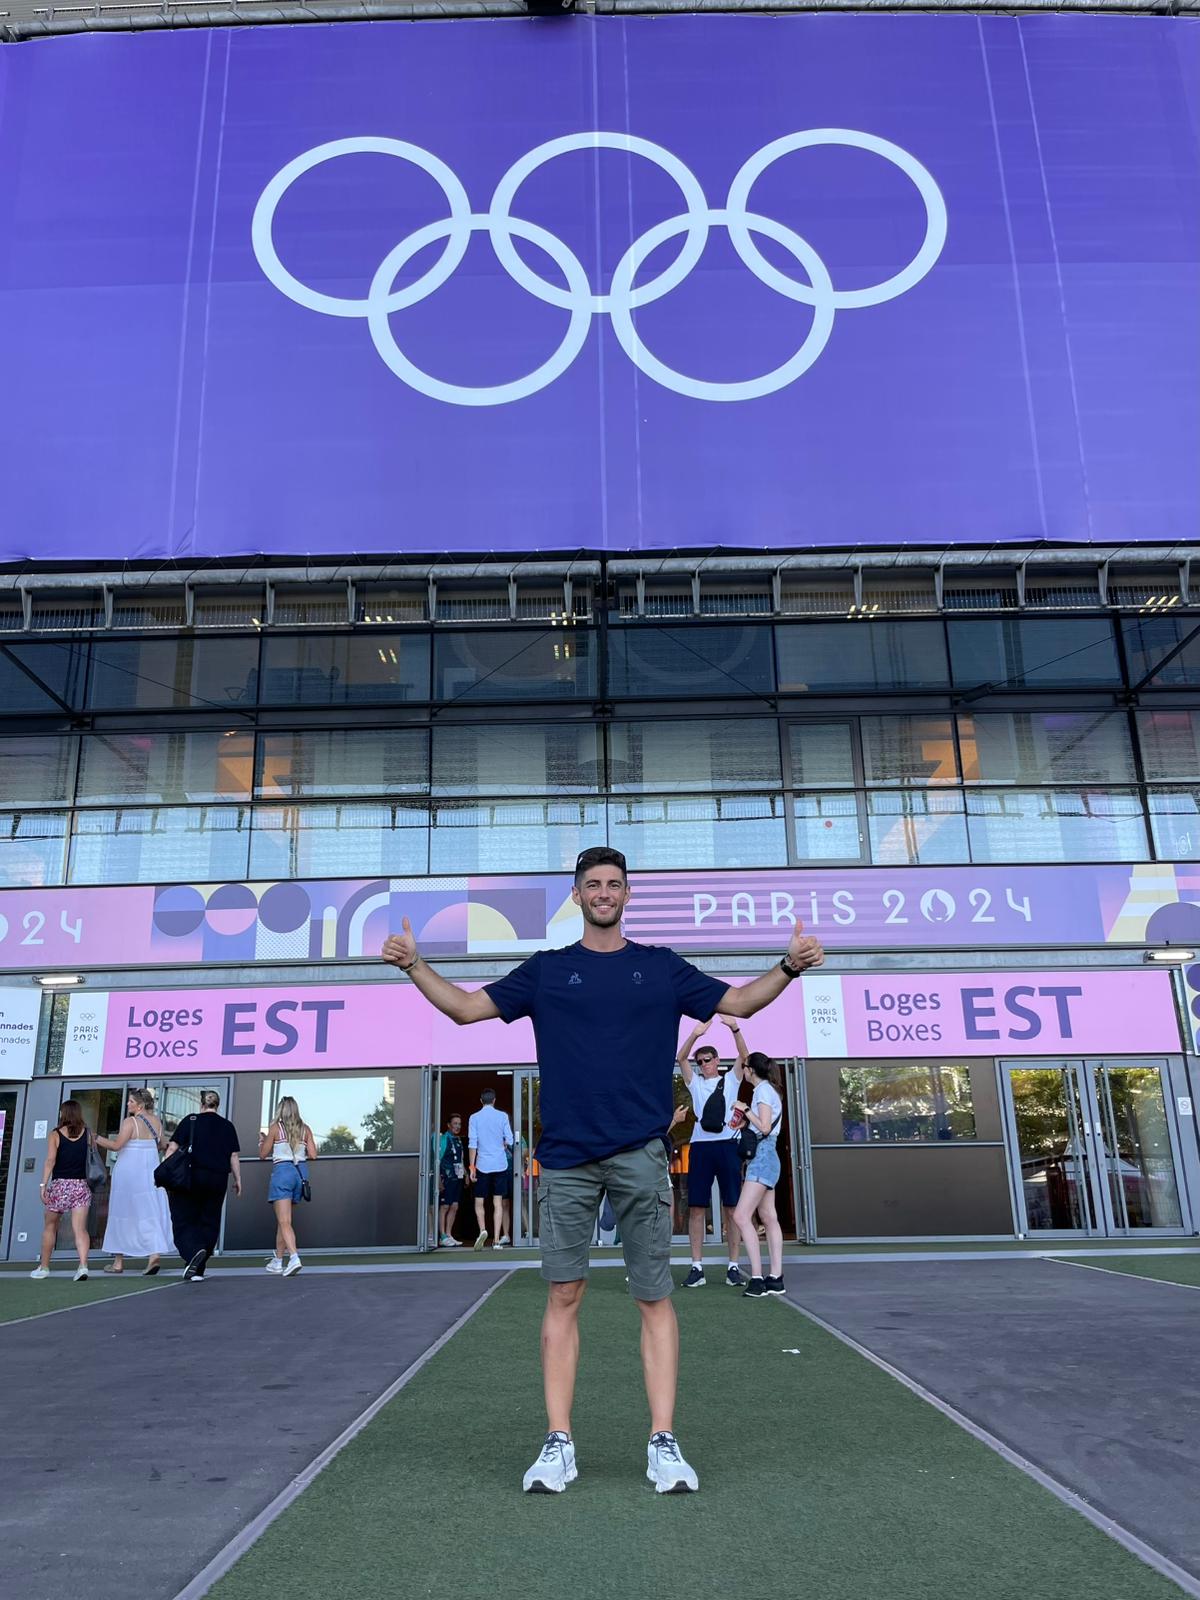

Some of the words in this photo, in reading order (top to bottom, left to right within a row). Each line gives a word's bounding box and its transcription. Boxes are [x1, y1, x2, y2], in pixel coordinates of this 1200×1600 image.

[882, 888, 1032, 924] 2024
[0, 910, 82, 945] 24
[864, 989, 941, 1017] Loges
[960, 985, 1083, 1041] EST
[0, 1023, 34, 1031] nnades
[127, 1006, 203, 1033] Loges
[221, 1000, 345, 1056] EST
[811, 1016, 838, 1024] 2024
[867, 1019, 942, 1045] Boxes
[0, 1036, 31, 1045] nnades
[73, 1033, 98, 1042] 2024
[125, 1036, 199, 1059] Boxes
